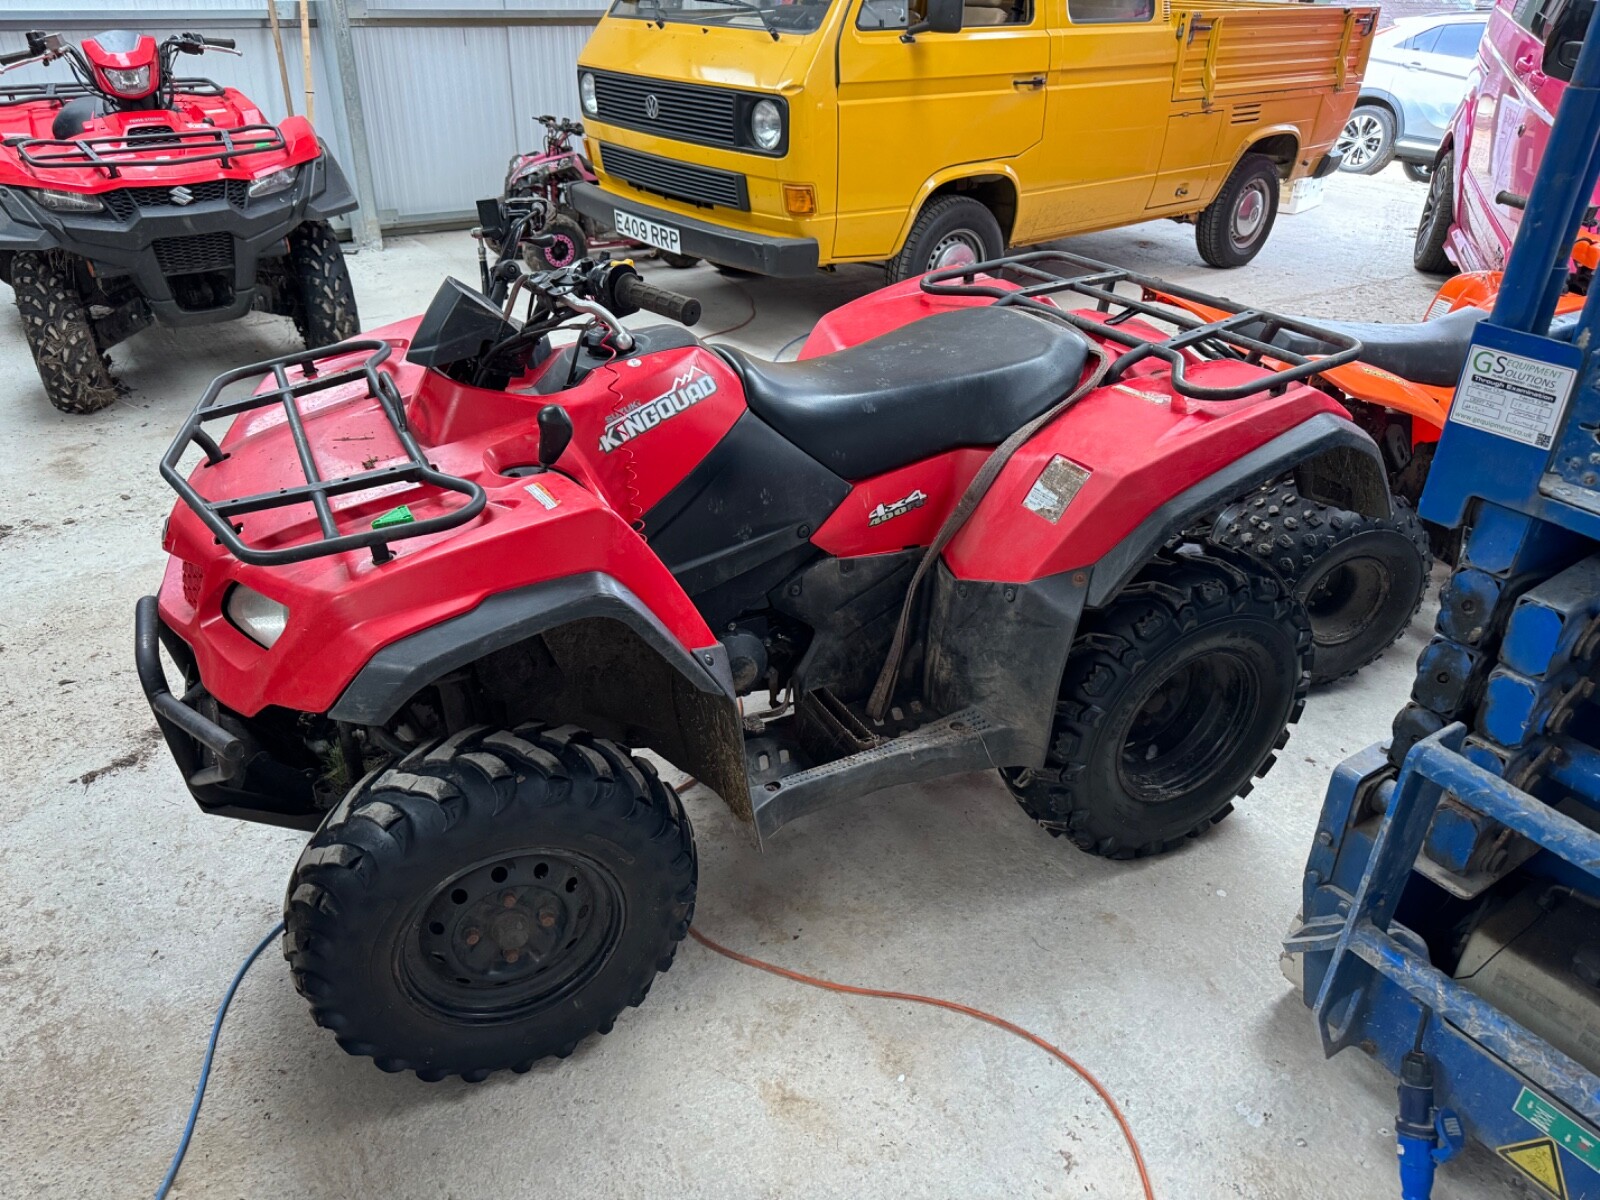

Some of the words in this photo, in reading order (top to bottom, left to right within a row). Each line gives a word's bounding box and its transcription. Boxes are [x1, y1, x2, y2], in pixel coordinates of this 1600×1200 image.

[615, 212, 648, 241] E409
[650, 224, 679, 250] RRP
[1506, 359, 1564, 378] EQUIPMENT
[1506, 384, 1554, 402] Examination
[600, 375, 717, 452] KINGQUAD
